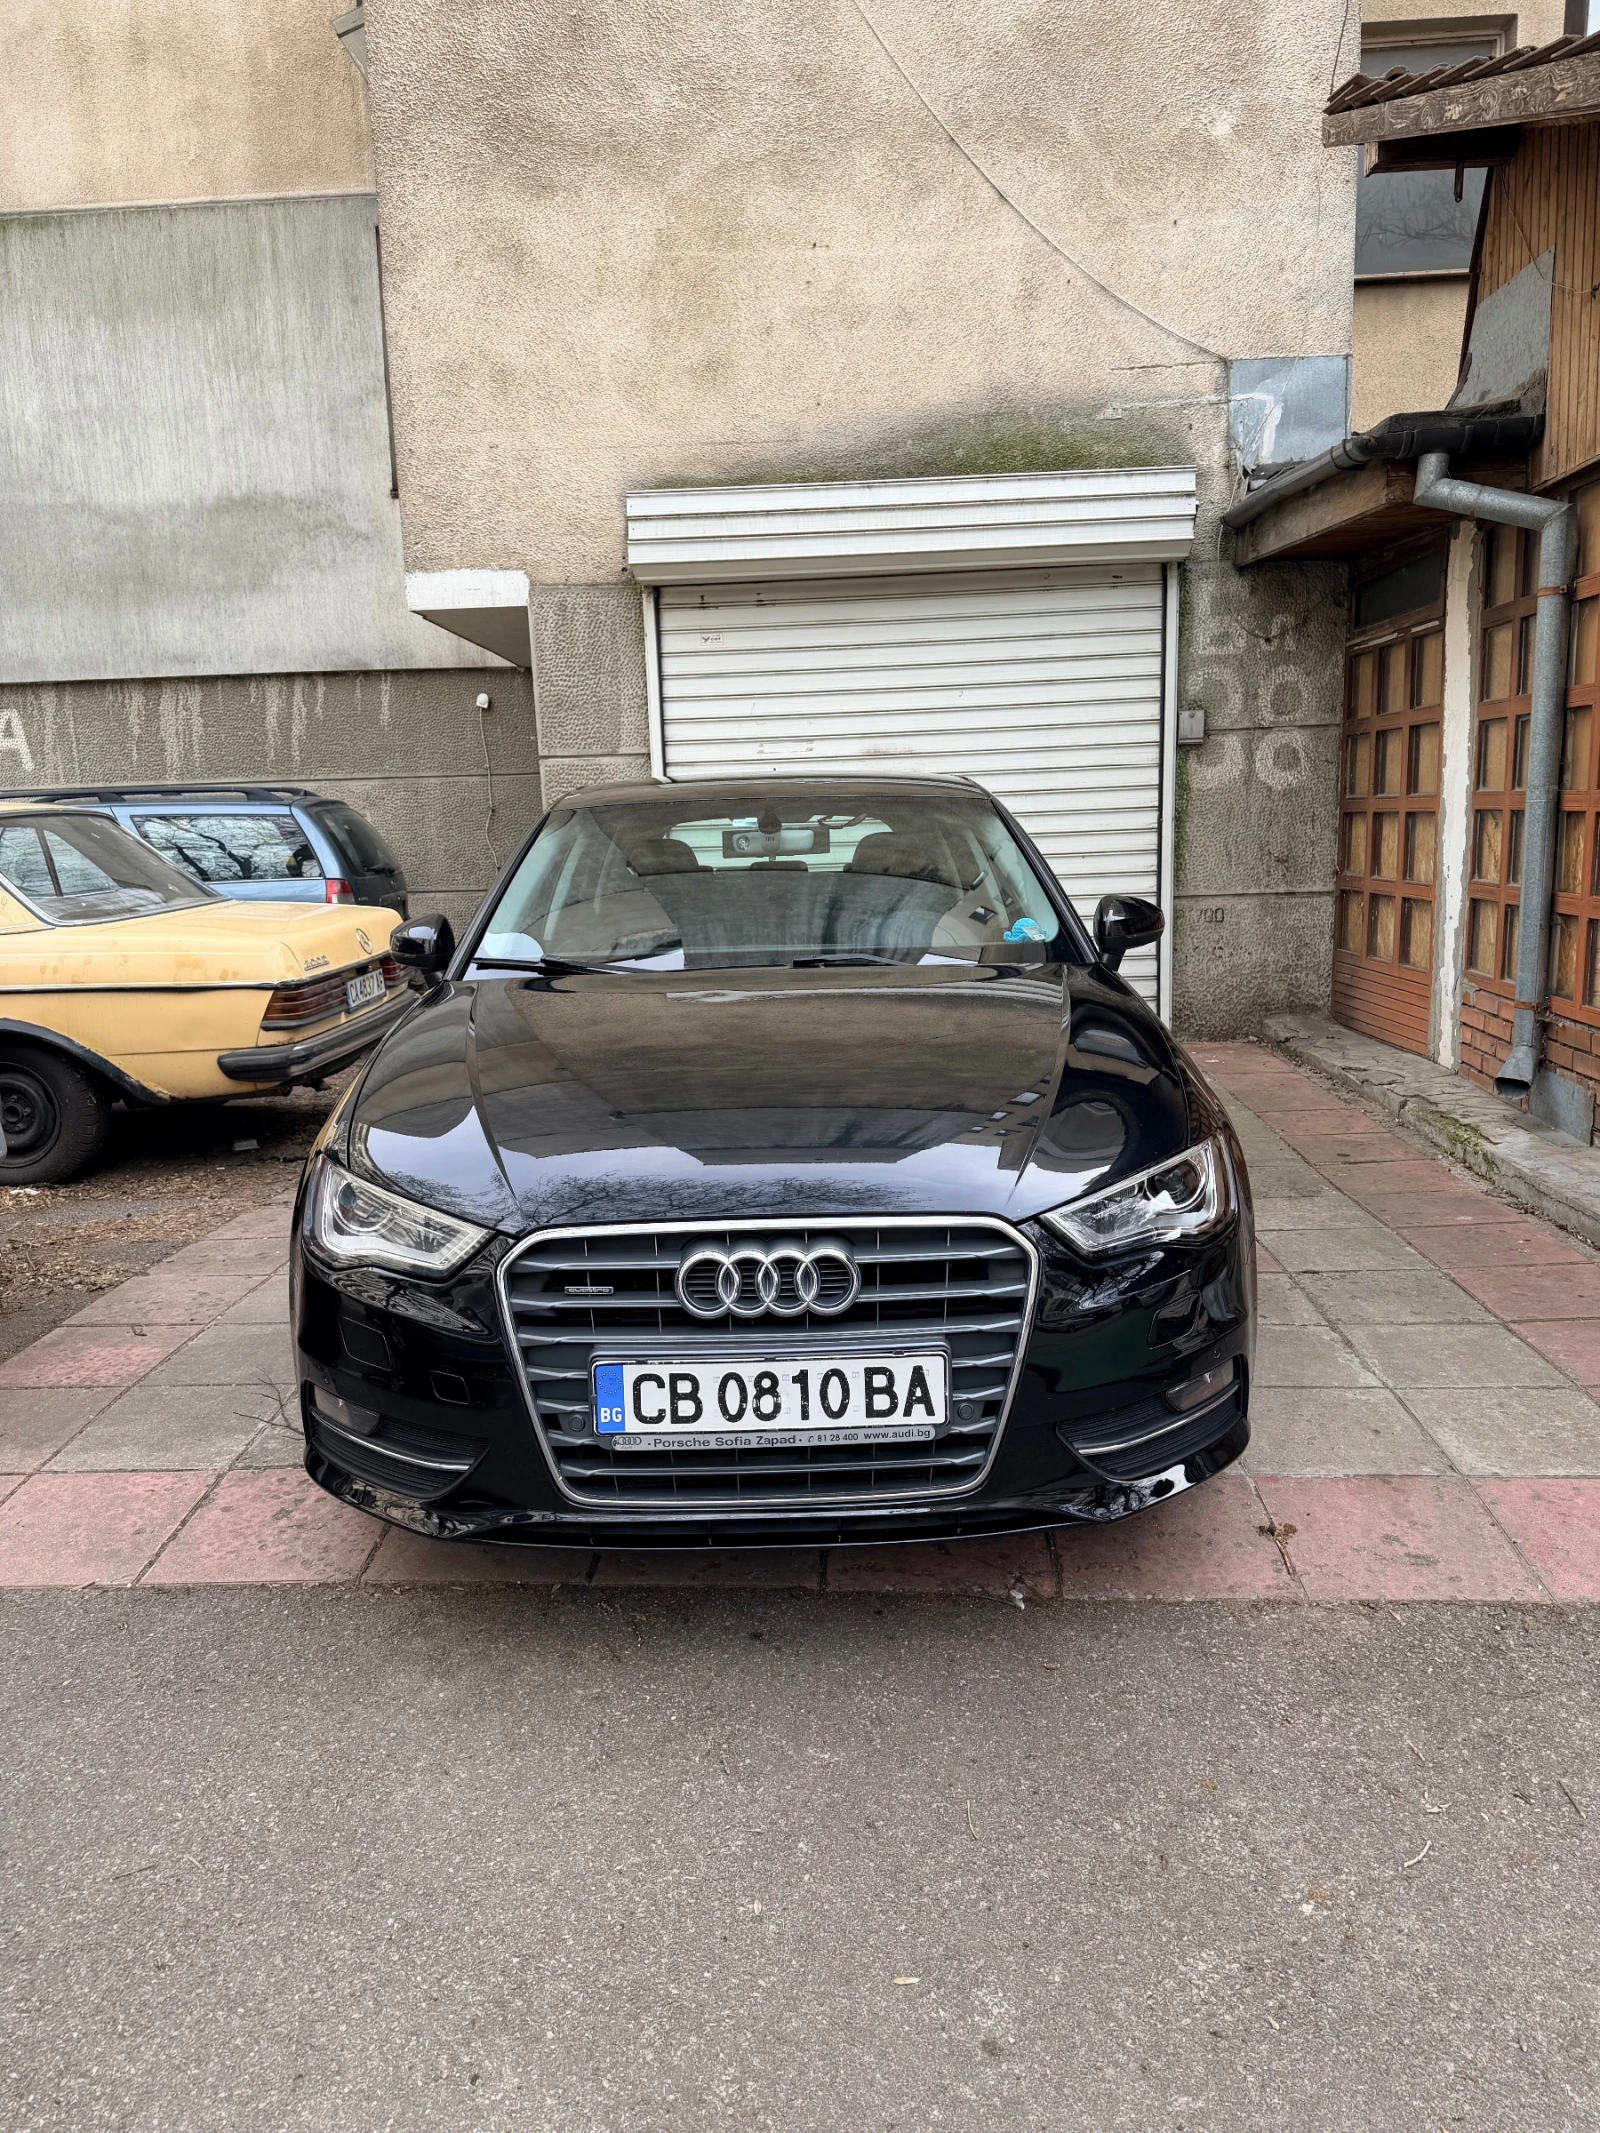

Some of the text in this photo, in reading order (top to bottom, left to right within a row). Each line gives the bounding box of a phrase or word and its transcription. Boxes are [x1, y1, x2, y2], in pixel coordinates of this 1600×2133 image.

[632, 1365, 936, 1424] CB 0810 BA
[600, 1407, 623, 1423] BG
[653, 1429, 931, 1448] Porsche Sofia Zapad 81 28 400 www.audi.bg
